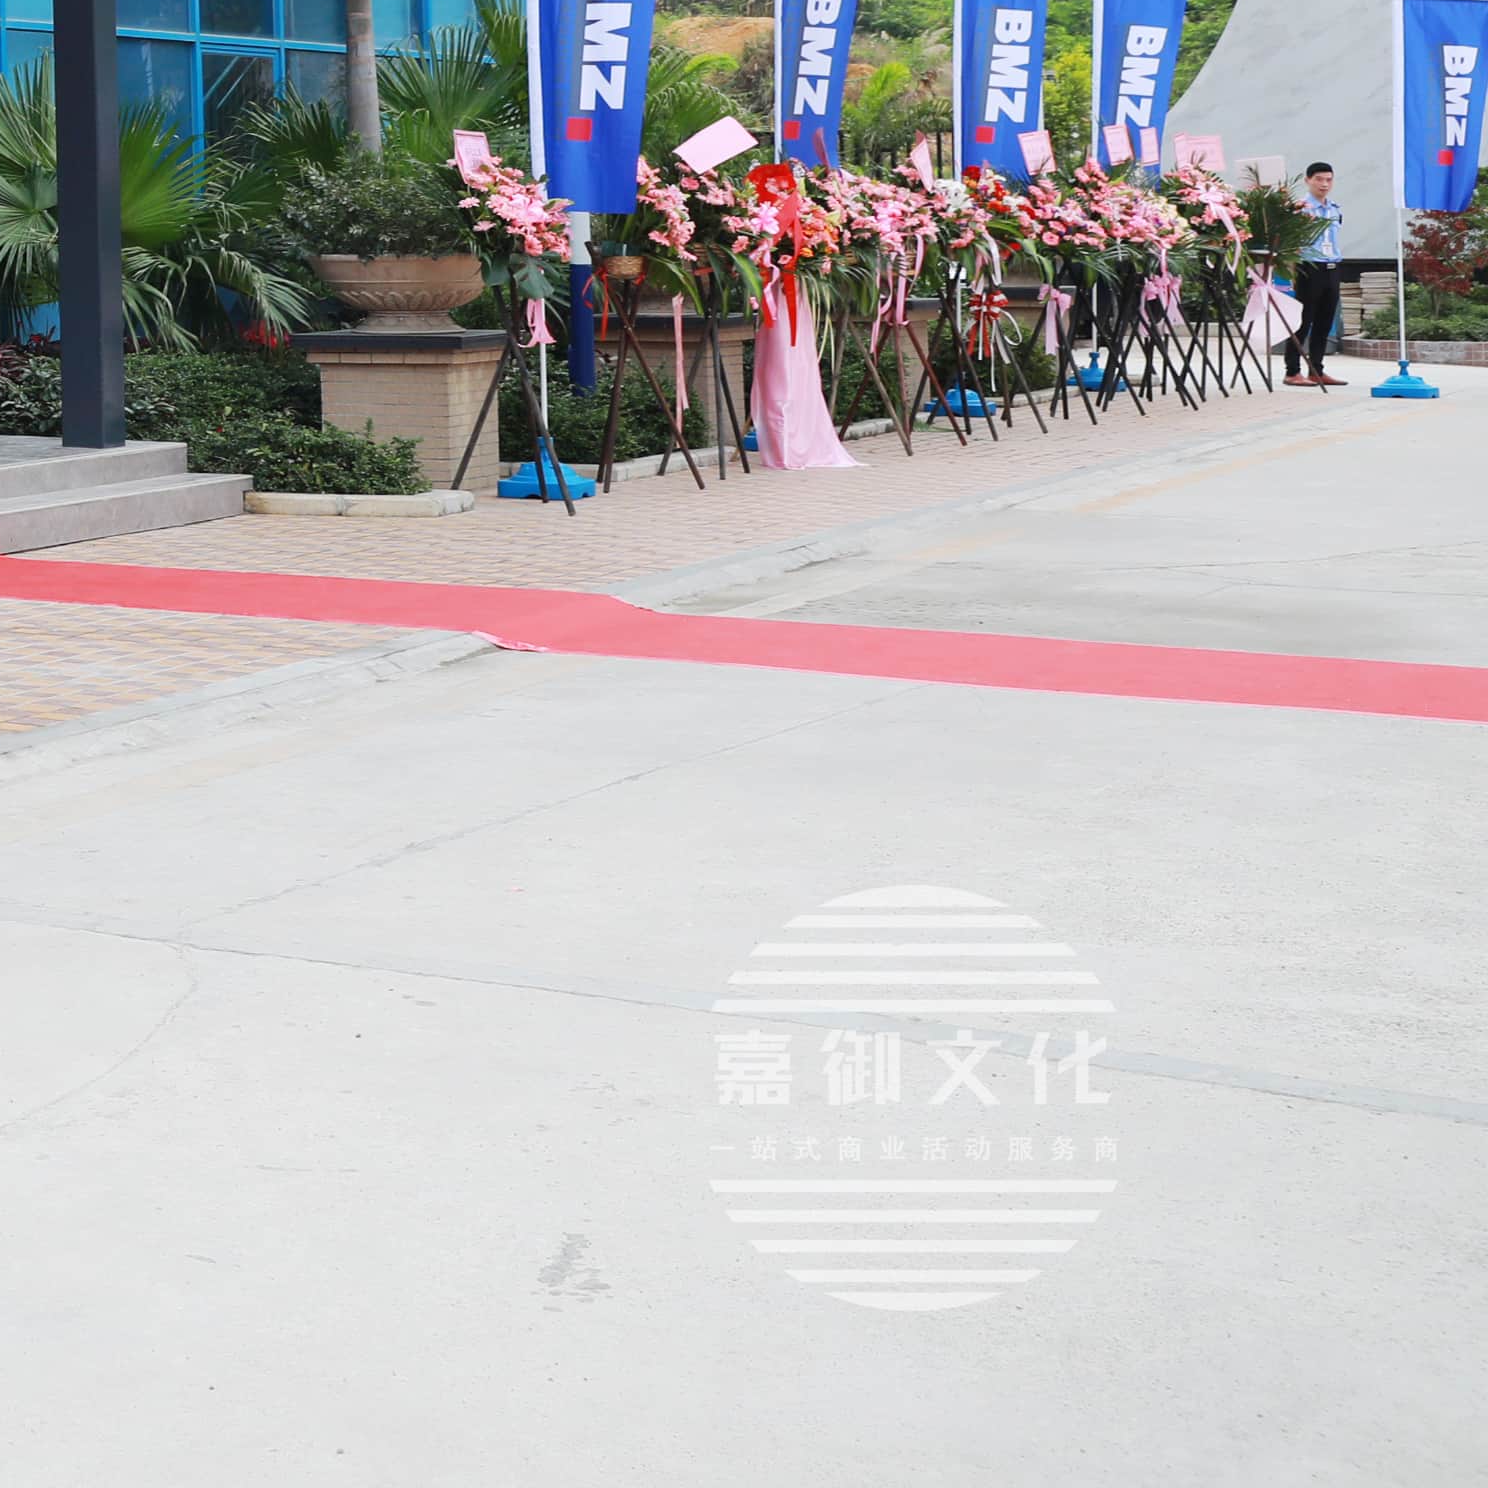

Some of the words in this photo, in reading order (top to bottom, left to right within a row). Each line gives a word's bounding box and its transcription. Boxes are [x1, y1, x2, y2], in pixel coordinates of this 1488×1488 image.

[984, 8, 1033, 123] BMZ
[1115, 25, 1168, 127] BMZ
[1442, 45, 1479, 147] BMZ
